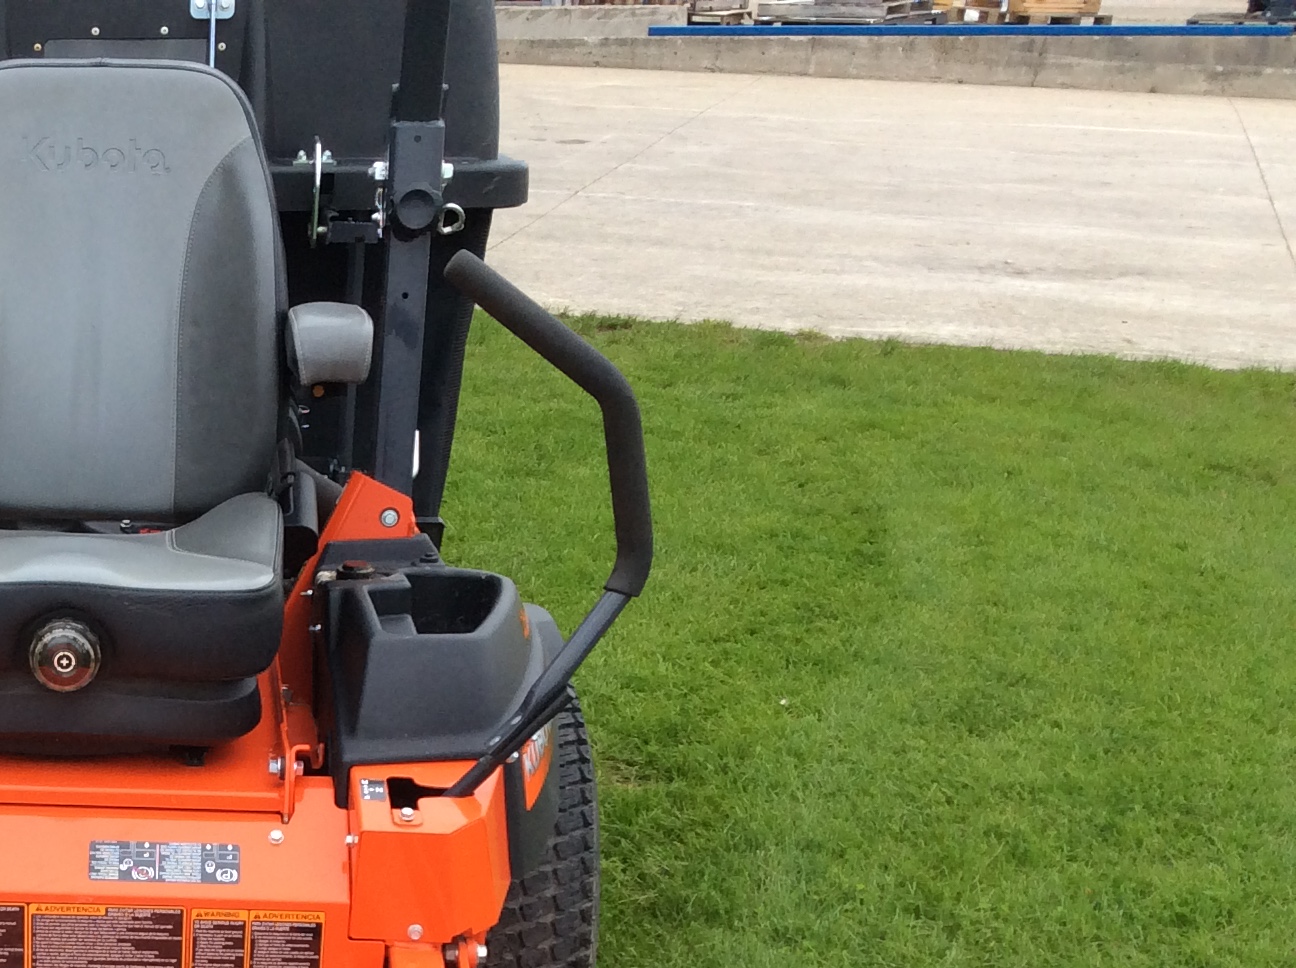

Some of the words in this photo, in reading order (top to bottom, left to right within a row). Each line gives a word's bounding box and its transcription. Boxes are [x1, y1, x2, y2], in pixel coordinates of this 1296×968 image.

[21, 136, 166, 177] Kubota
[44, 905, 101, 914] ADVERTENCIA
[262, 912, 321, 920] ADVERTENCIA
